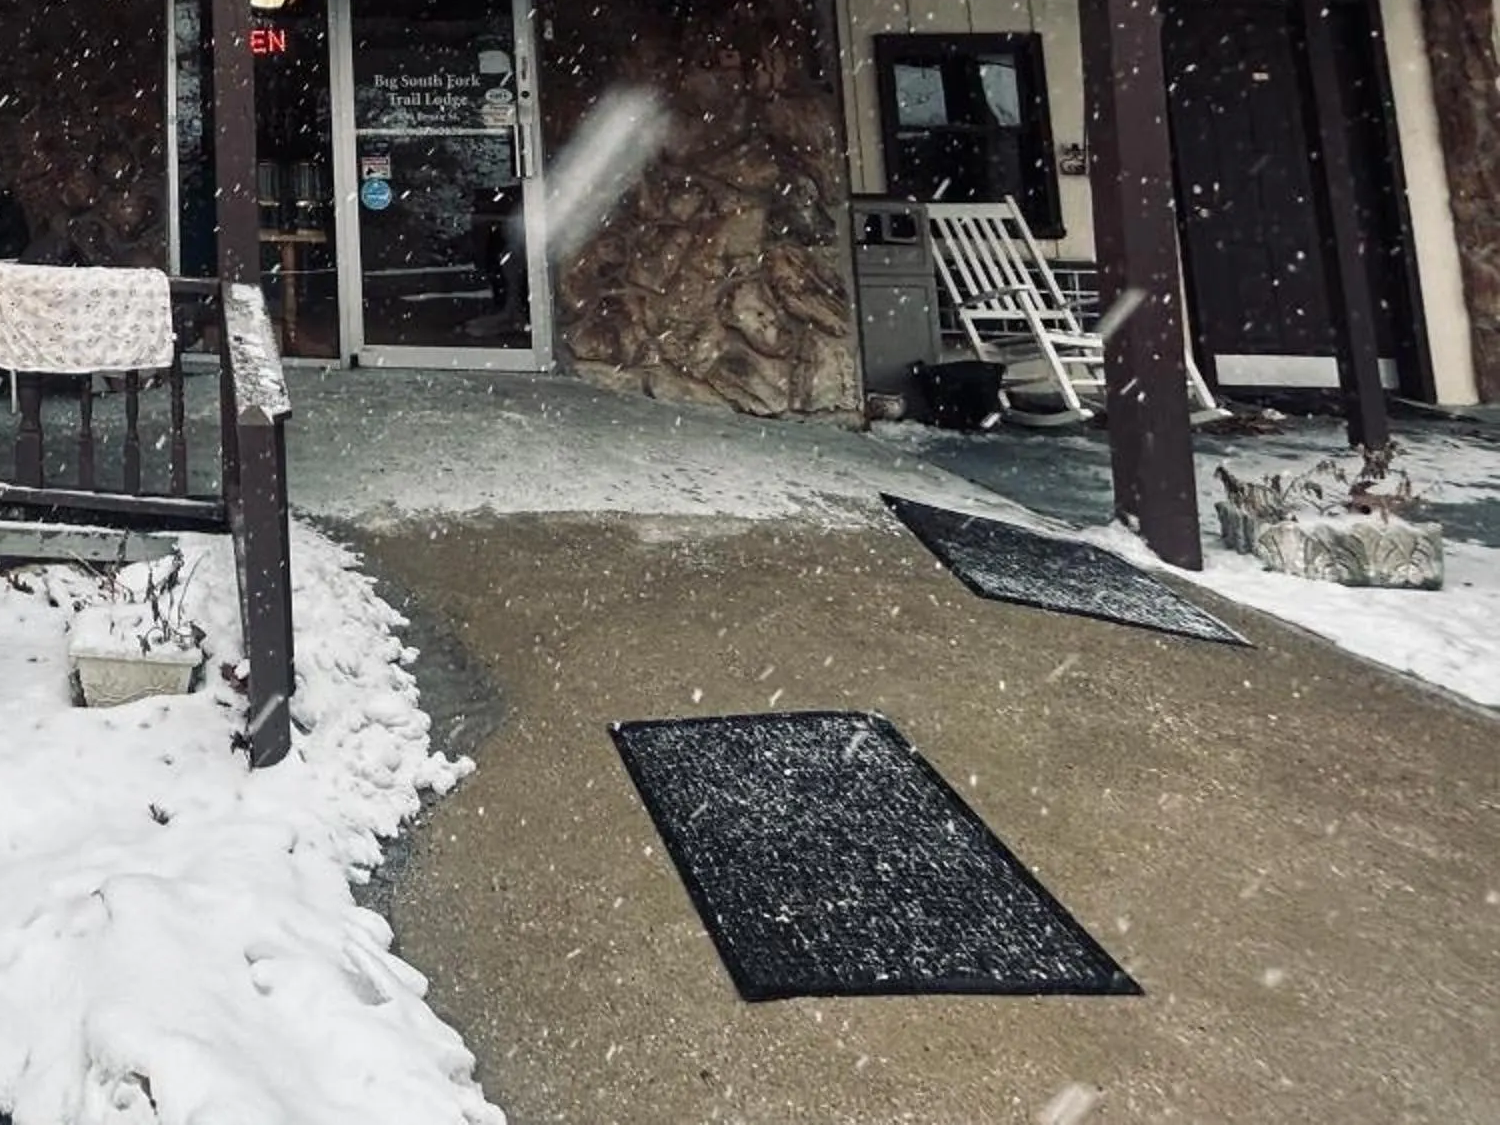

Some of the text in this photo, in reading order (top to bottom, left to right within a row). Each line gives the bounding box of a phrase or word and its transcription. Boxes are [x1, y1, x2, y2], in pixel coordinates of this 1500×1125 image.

[249, 29, 286, 54] EN
[373, 73, 481, 90] Big South Fork
[387, 92, 469, 109] Trail Lodge
